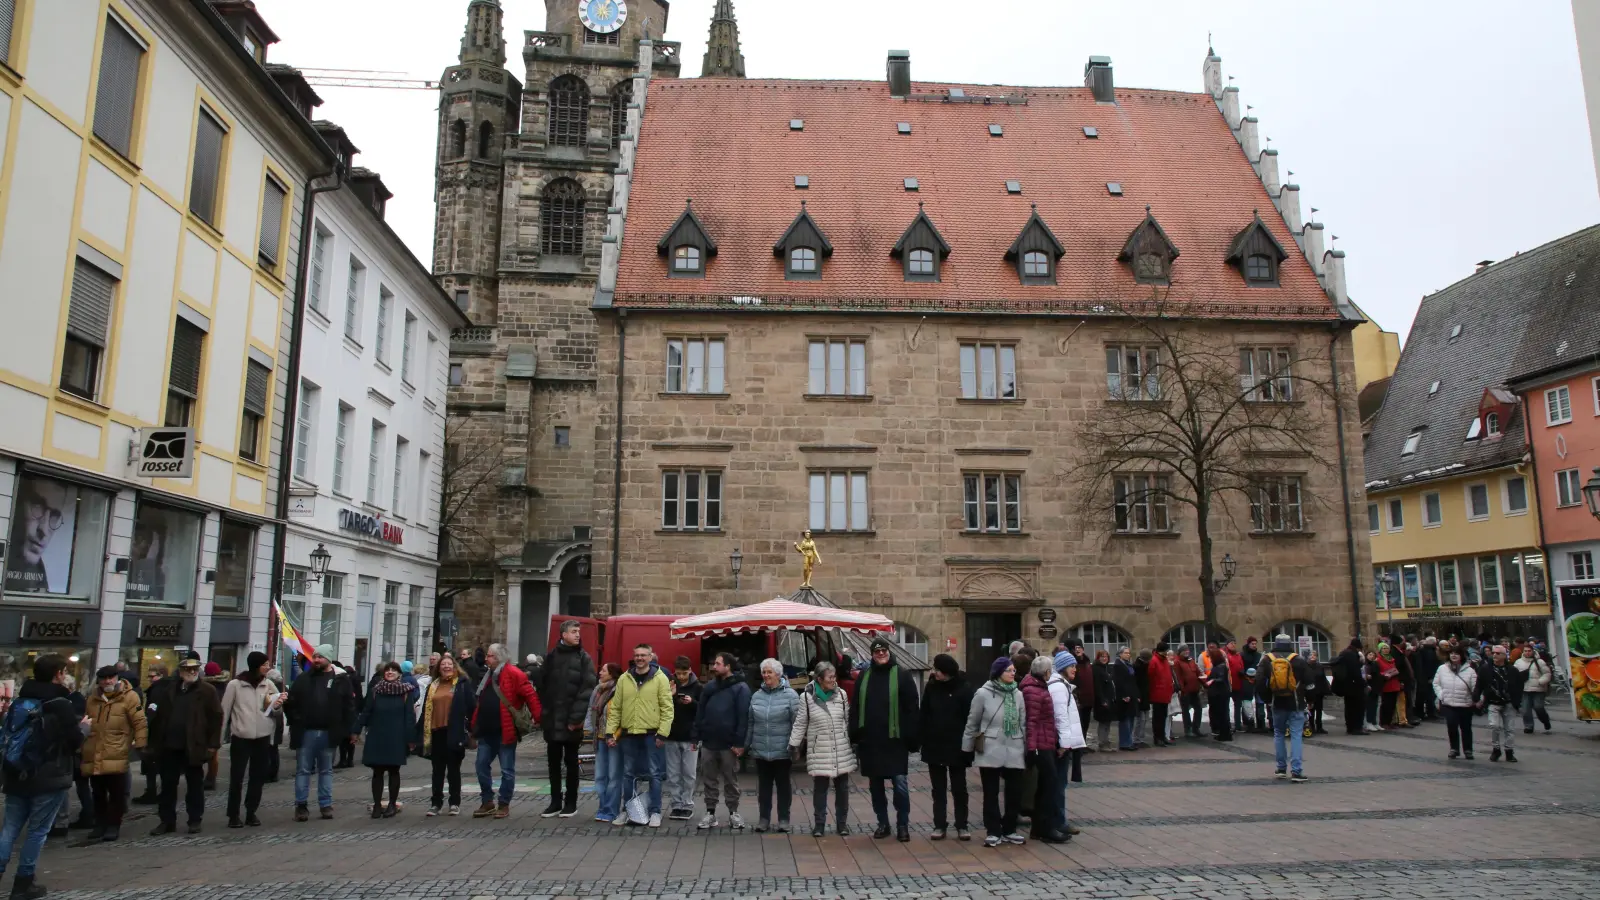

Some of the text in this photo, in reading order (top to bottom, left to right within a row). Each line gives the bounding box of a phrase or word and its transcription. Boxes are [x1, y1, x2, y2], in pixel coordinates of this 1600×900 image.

[141, 459, 183, 472] rosset
[342, 508, 404, 545] TARGO BANK
[27, 618, 82, 638] rosset
[143, 620, 183, 638] rosset
